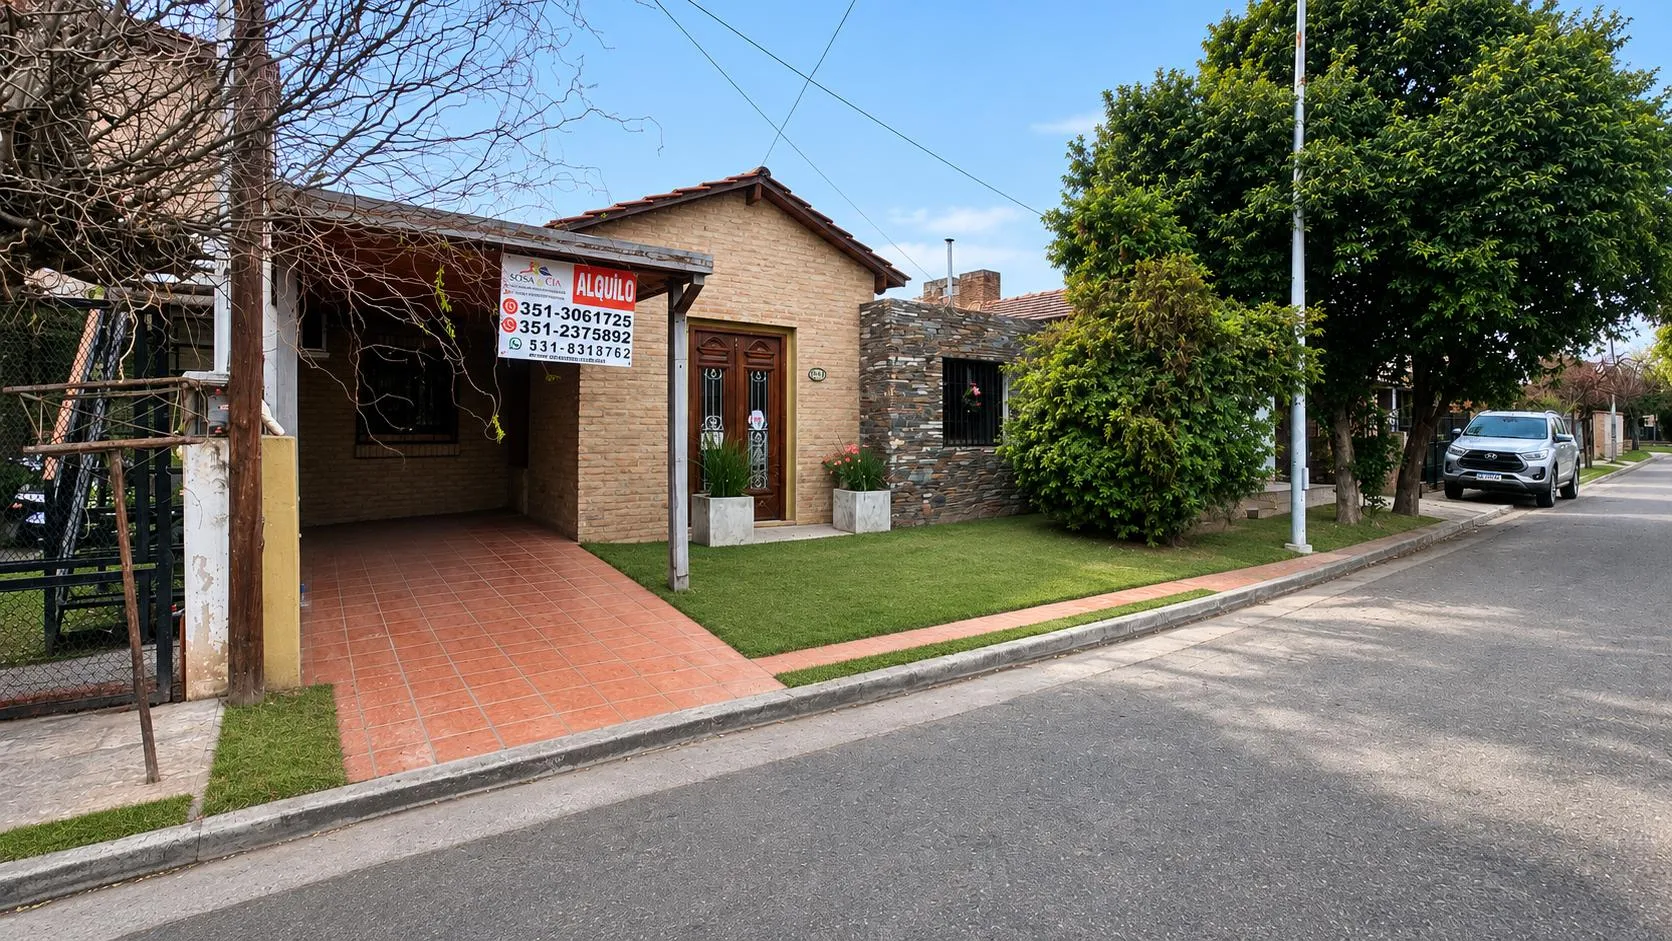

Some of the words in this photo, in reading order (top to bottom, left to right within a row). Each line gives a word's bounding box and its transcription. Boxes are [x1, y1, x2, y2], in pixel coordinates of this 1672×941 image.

[510, 273, 535, 284] SOSA
[545, 277, 561, 288] CIA
[520, 301, 632, 328] 351-3061725
[519, 319, 631, 344] 351-2375892
